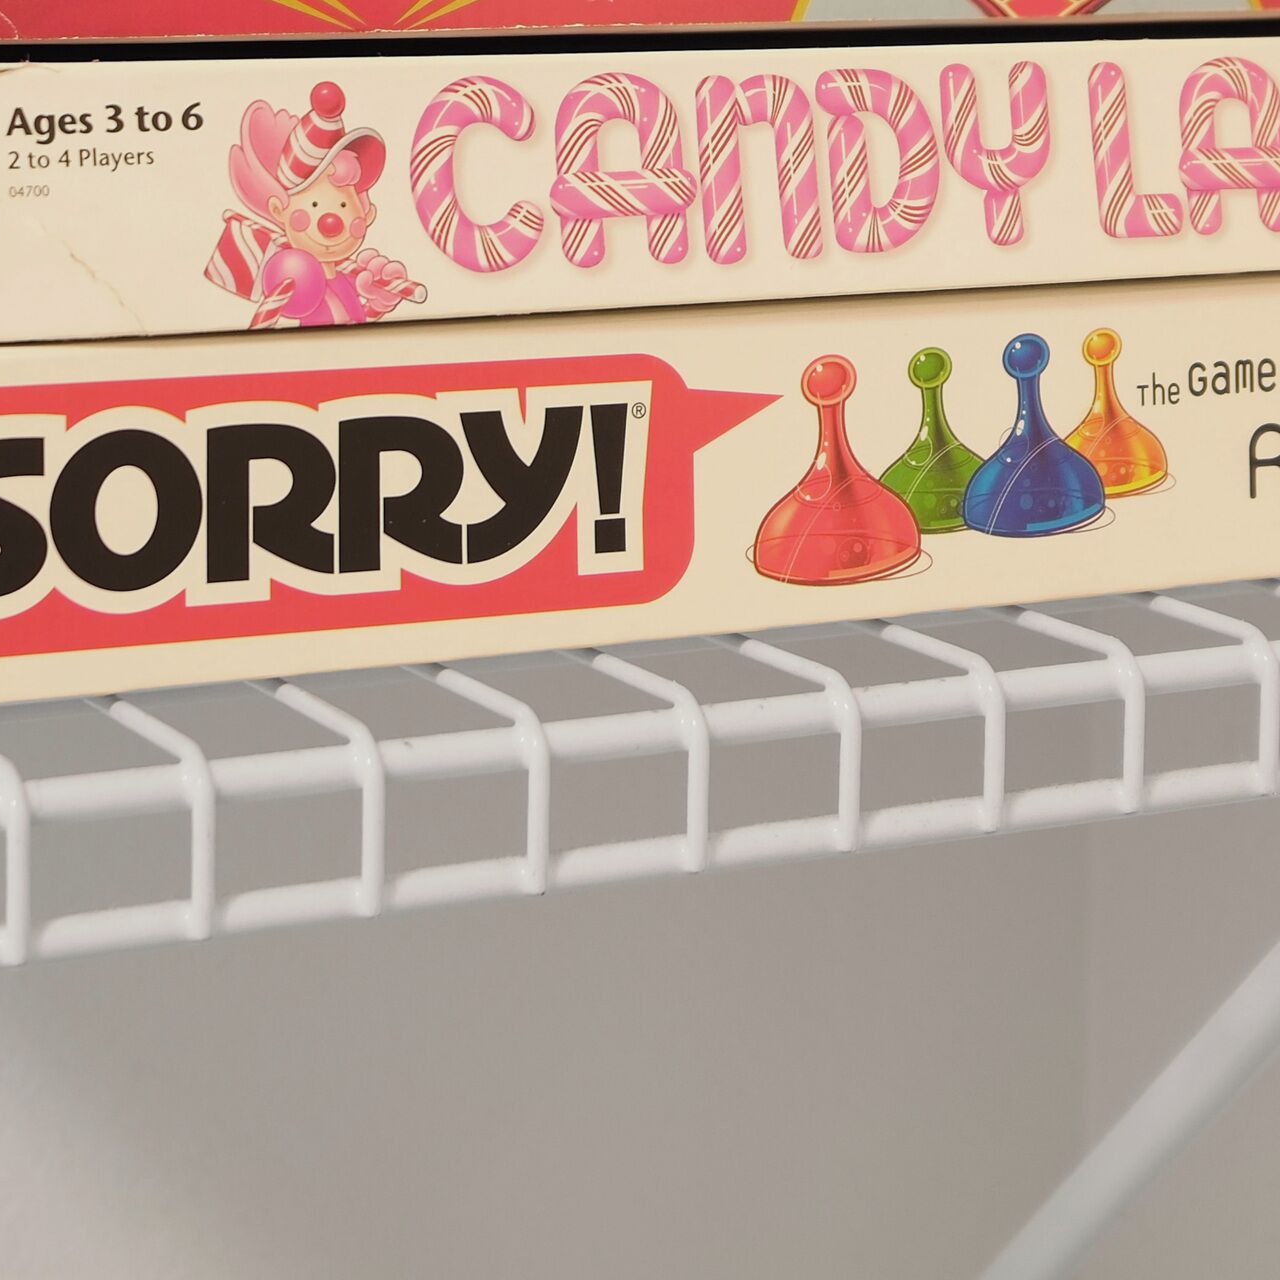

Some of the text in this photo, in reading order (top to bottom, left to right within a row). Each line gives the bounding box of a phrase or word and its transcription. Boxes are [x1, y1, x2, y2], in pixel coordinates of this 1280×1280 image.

[6, 101, 204, 145] Ages 3 to 6
[8, 147, 155, 173] 2 to 4 Players
[409, 60, 1052, 273] CANDY
[8, 185, 51, 198] 04700
[1136, 372, 1180, 407] The
[1188, 357, 1277, 397] Game
